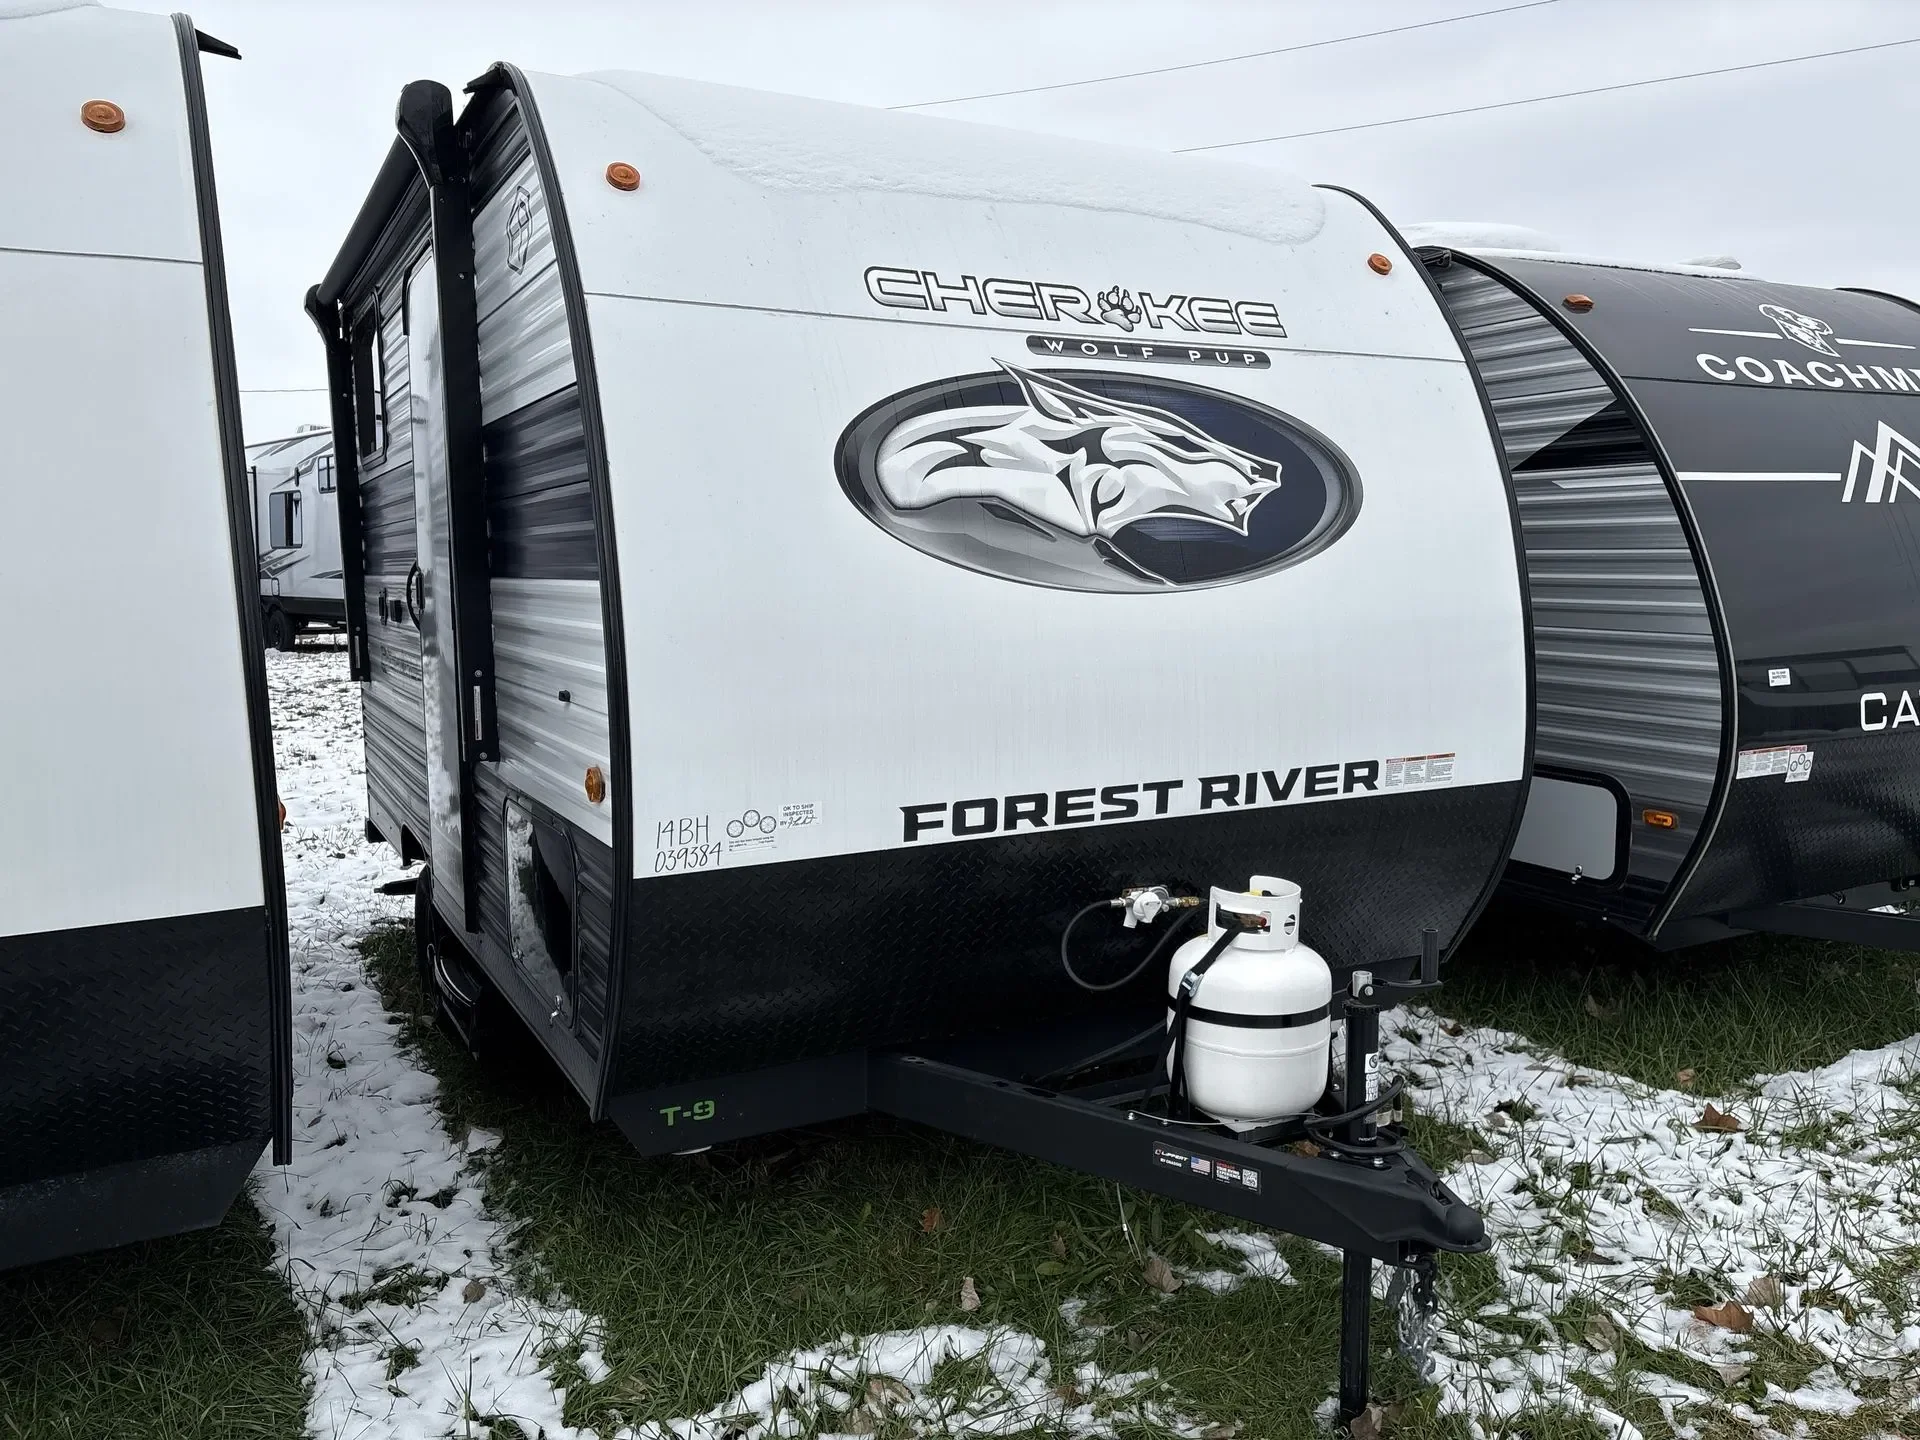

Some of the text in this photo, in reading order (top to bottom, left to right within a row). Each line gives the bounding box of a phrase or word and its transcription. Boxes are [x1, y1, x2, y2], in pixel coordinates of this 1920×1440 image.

[1044, 339, 1257, 366] WOLF PUP
[1696, 354, 1920, 393] COACHM
[1861, 689, 1920, 731] CA
[783, 809, 814, 817] INSPECTED
[899, 780, 1183, 842] FOREST
[1197, 759, 1379, 810] RIVER
[656, 815, 710, 849] 14BH
[654, 841, 723, 873] 039384
[660, 1100, 715, 1126] T-9
[1161, 1151, 1188, 1161] LIPPERT
